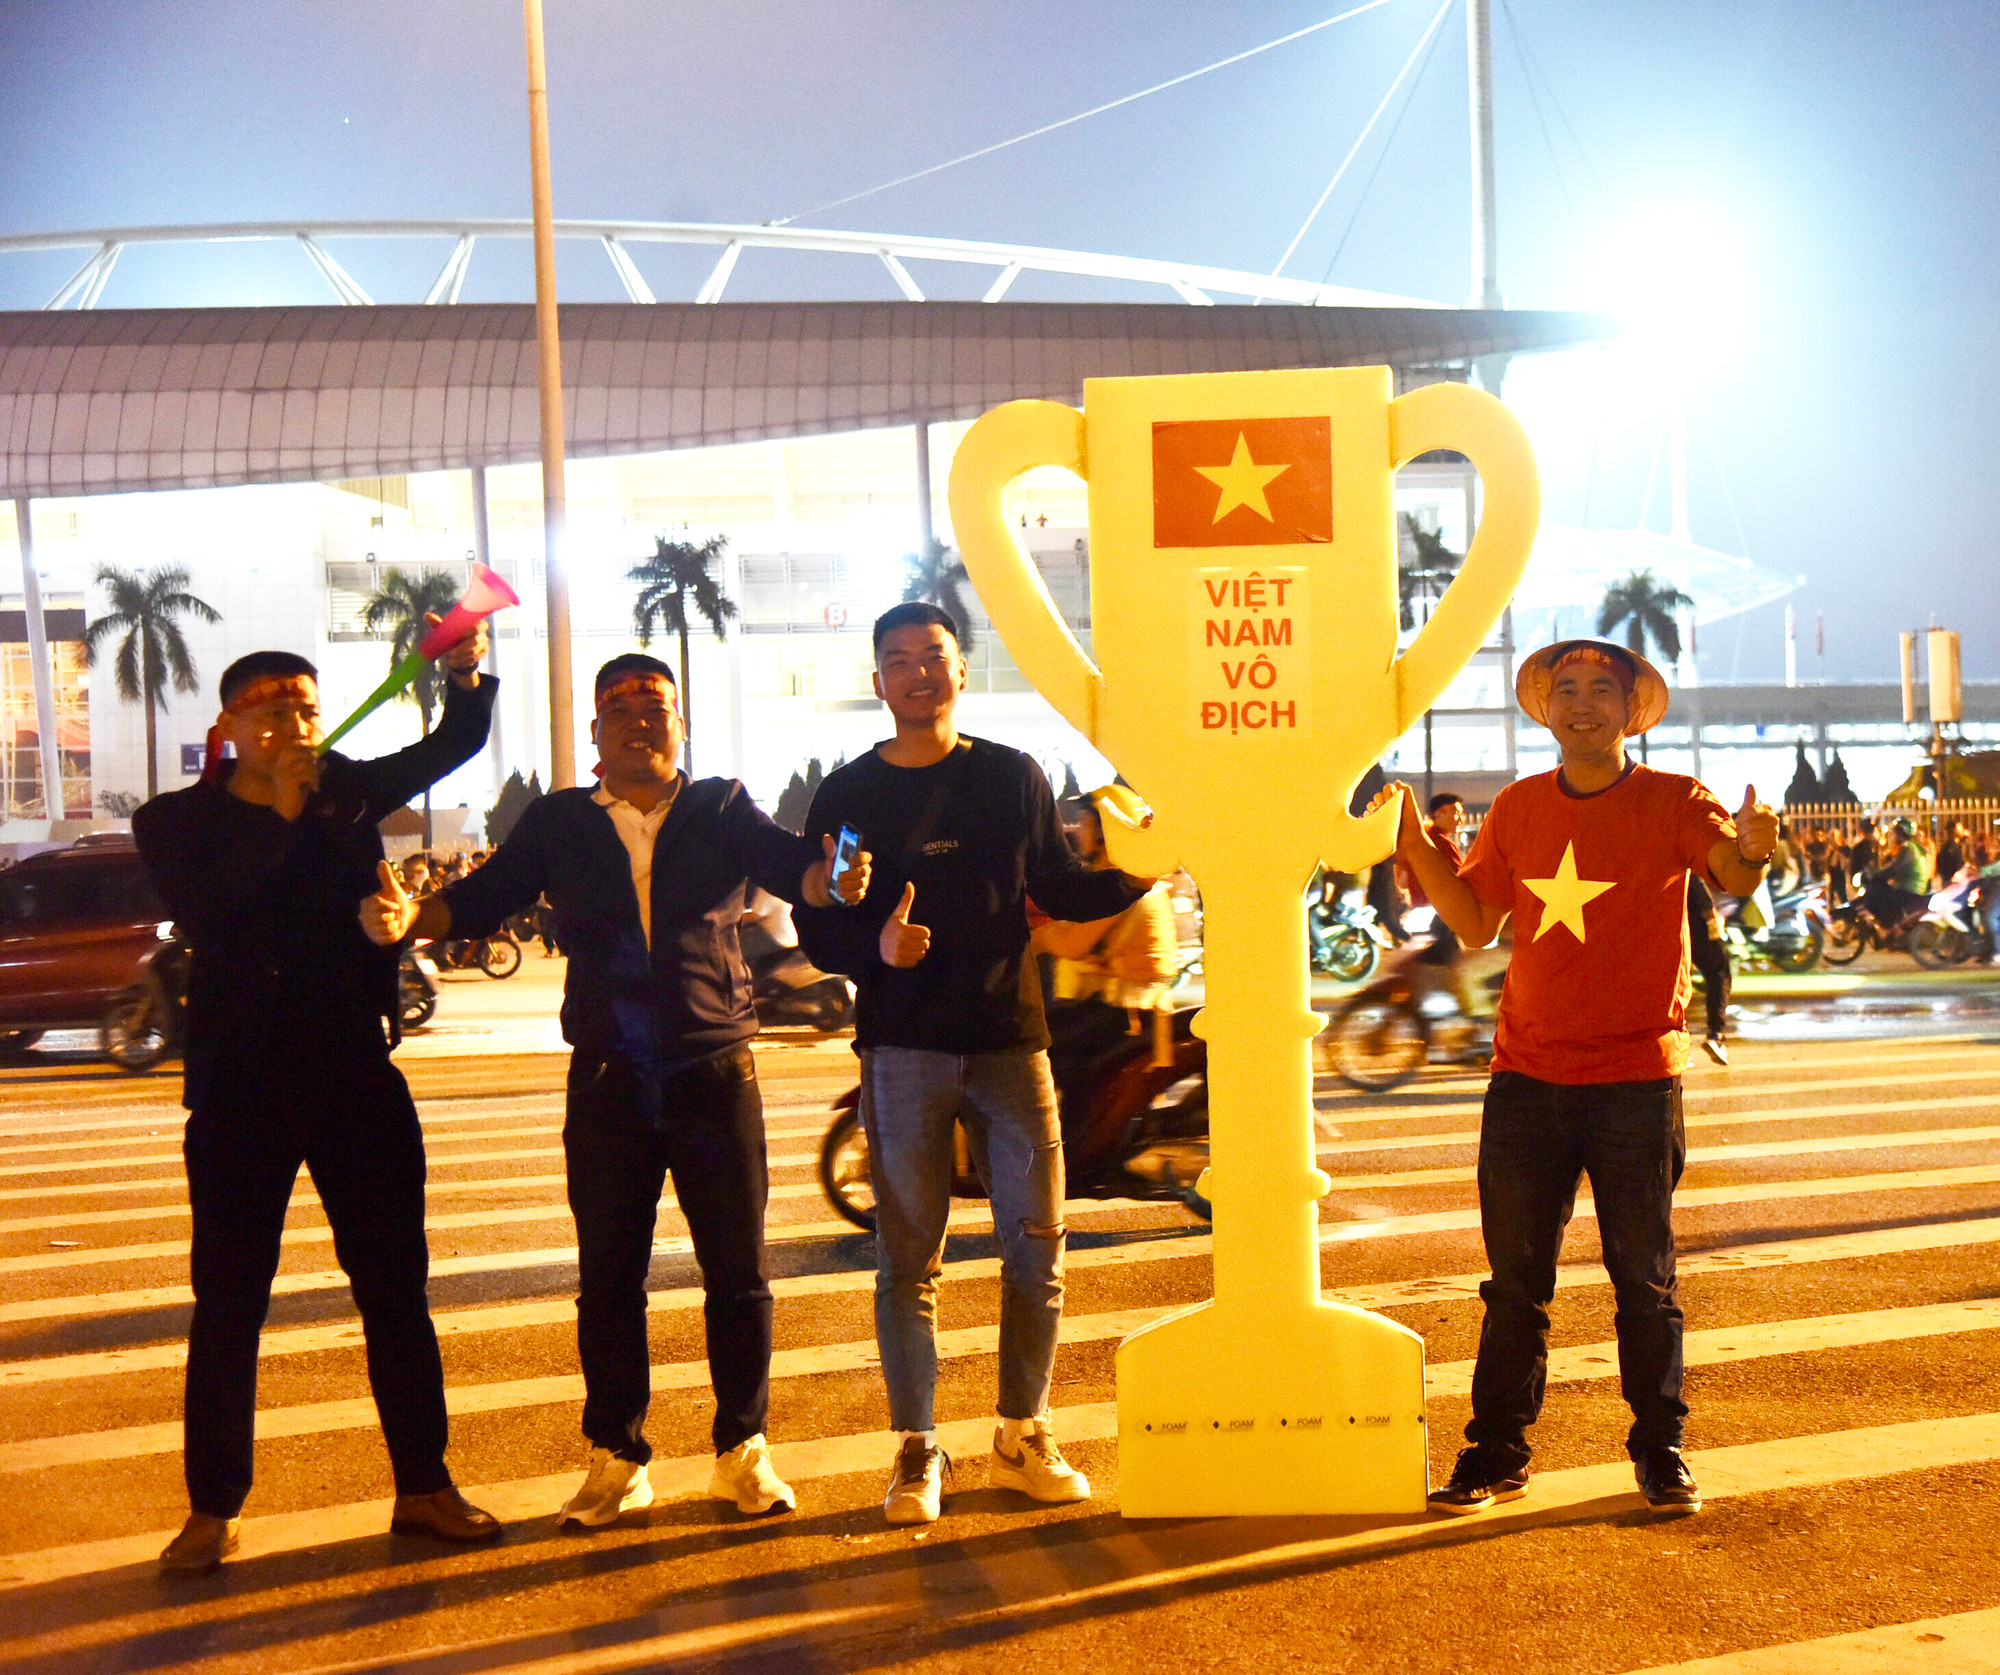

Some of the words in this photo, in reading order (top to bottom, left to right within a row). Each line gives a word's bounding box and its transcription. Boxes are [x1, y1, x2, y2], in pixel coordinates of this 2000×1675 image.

[1204, 571, 1292, 614] VIỆT
[1205, 618, 1292, 647] NAM
[1221, 653, 1277, 690] VÔ
[1200, 700, 1296, 735] ĐỊCH
[1162, 1422, 1187, 1432] FOAM
[1230, 1419, 1254, 1429] FOAM
[1297, 1417, 1322, 1427] FOAM
[1365, 1415, 1390, 1425] FOAM
